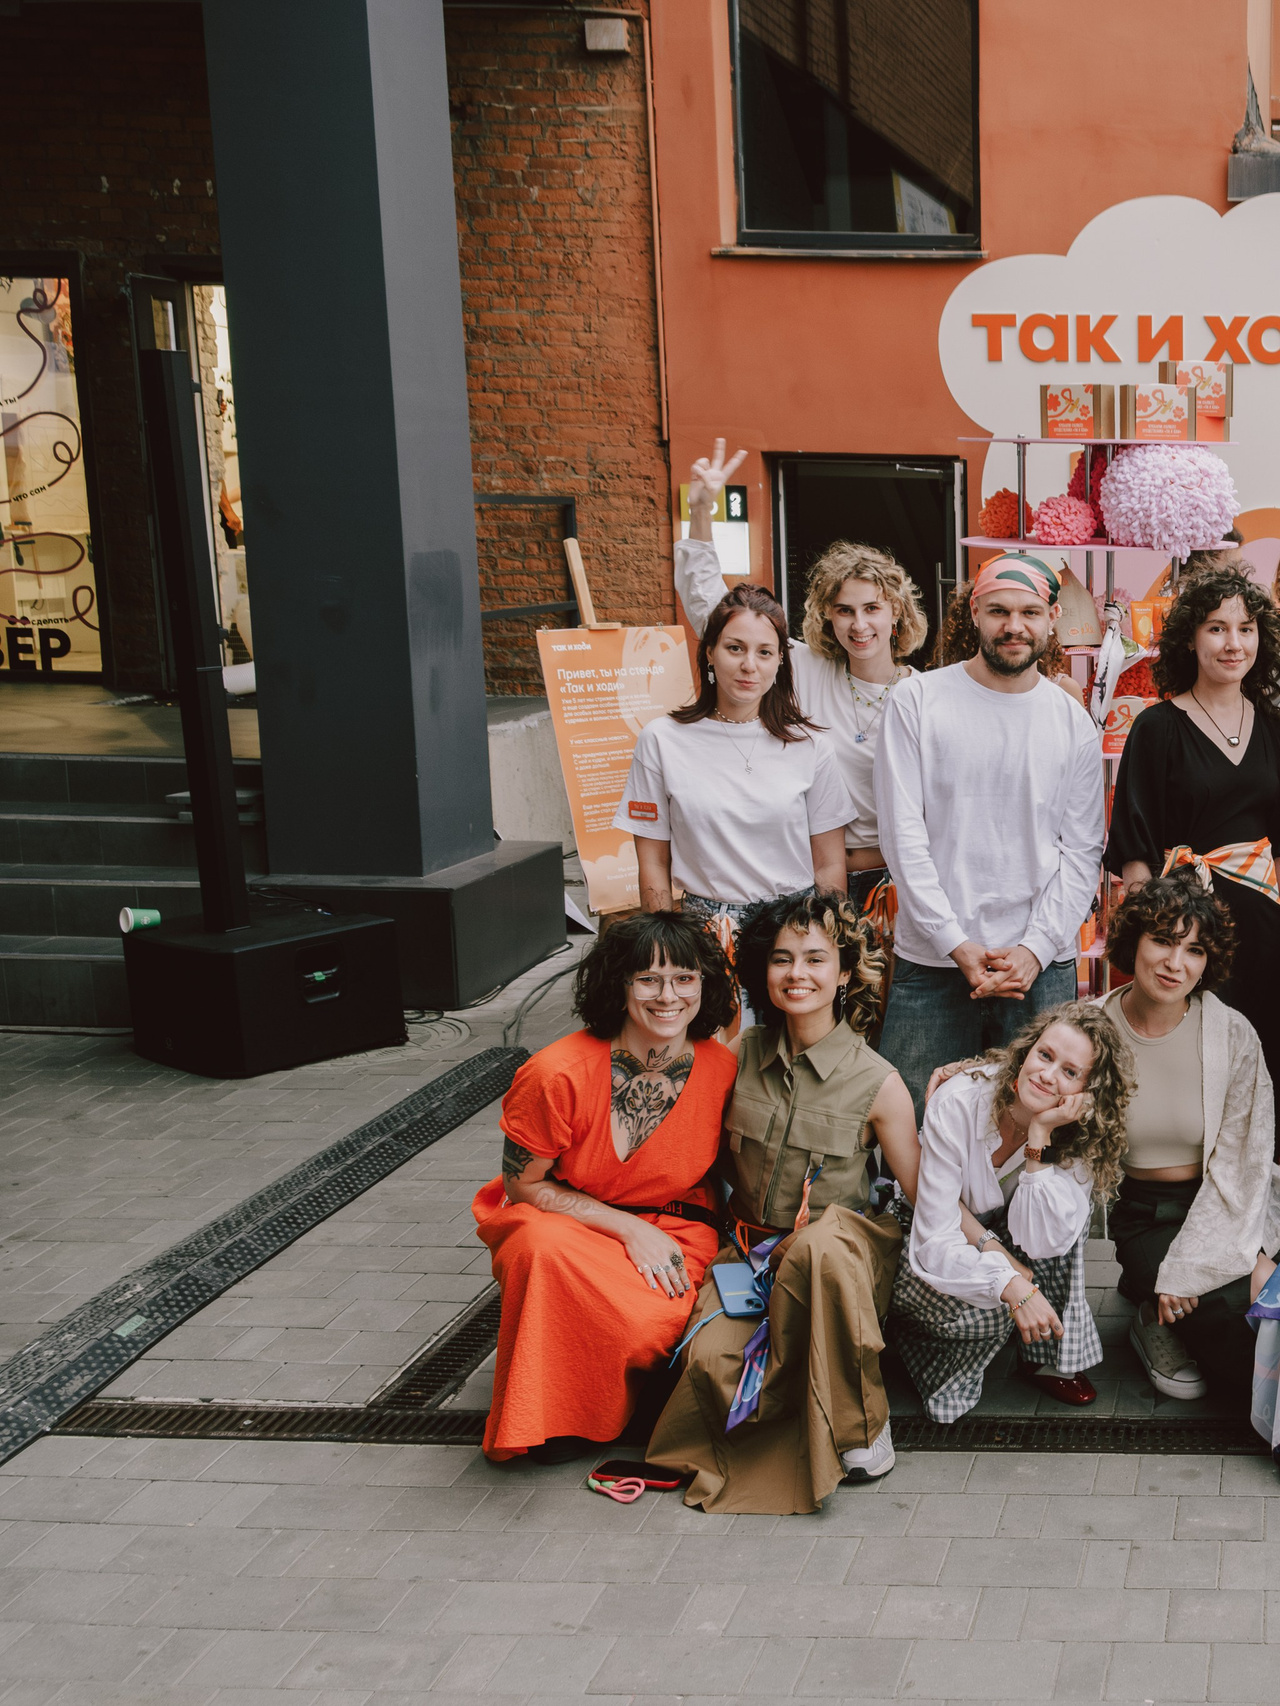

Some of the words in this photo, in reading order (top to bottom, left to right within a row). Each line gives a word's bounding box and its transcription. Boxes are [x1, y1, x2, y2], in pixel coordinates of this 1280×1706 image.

[971, 313, 1123, 364] так
[1137, 315, 1184, 363] и
[31, 617, 70, 626] сделать
[0, 627, 71, 671] ЕР
[557, 668, 599, 681] Привет,
[599, 668, 613, 677] ты
[614, 667, 627, 676] на
[628, 665, 665, 675] стенде
[560, 682, 585, 693] «Так
[586, 683, 594, 692] и
[595, 682, 625, 692] ходи»
